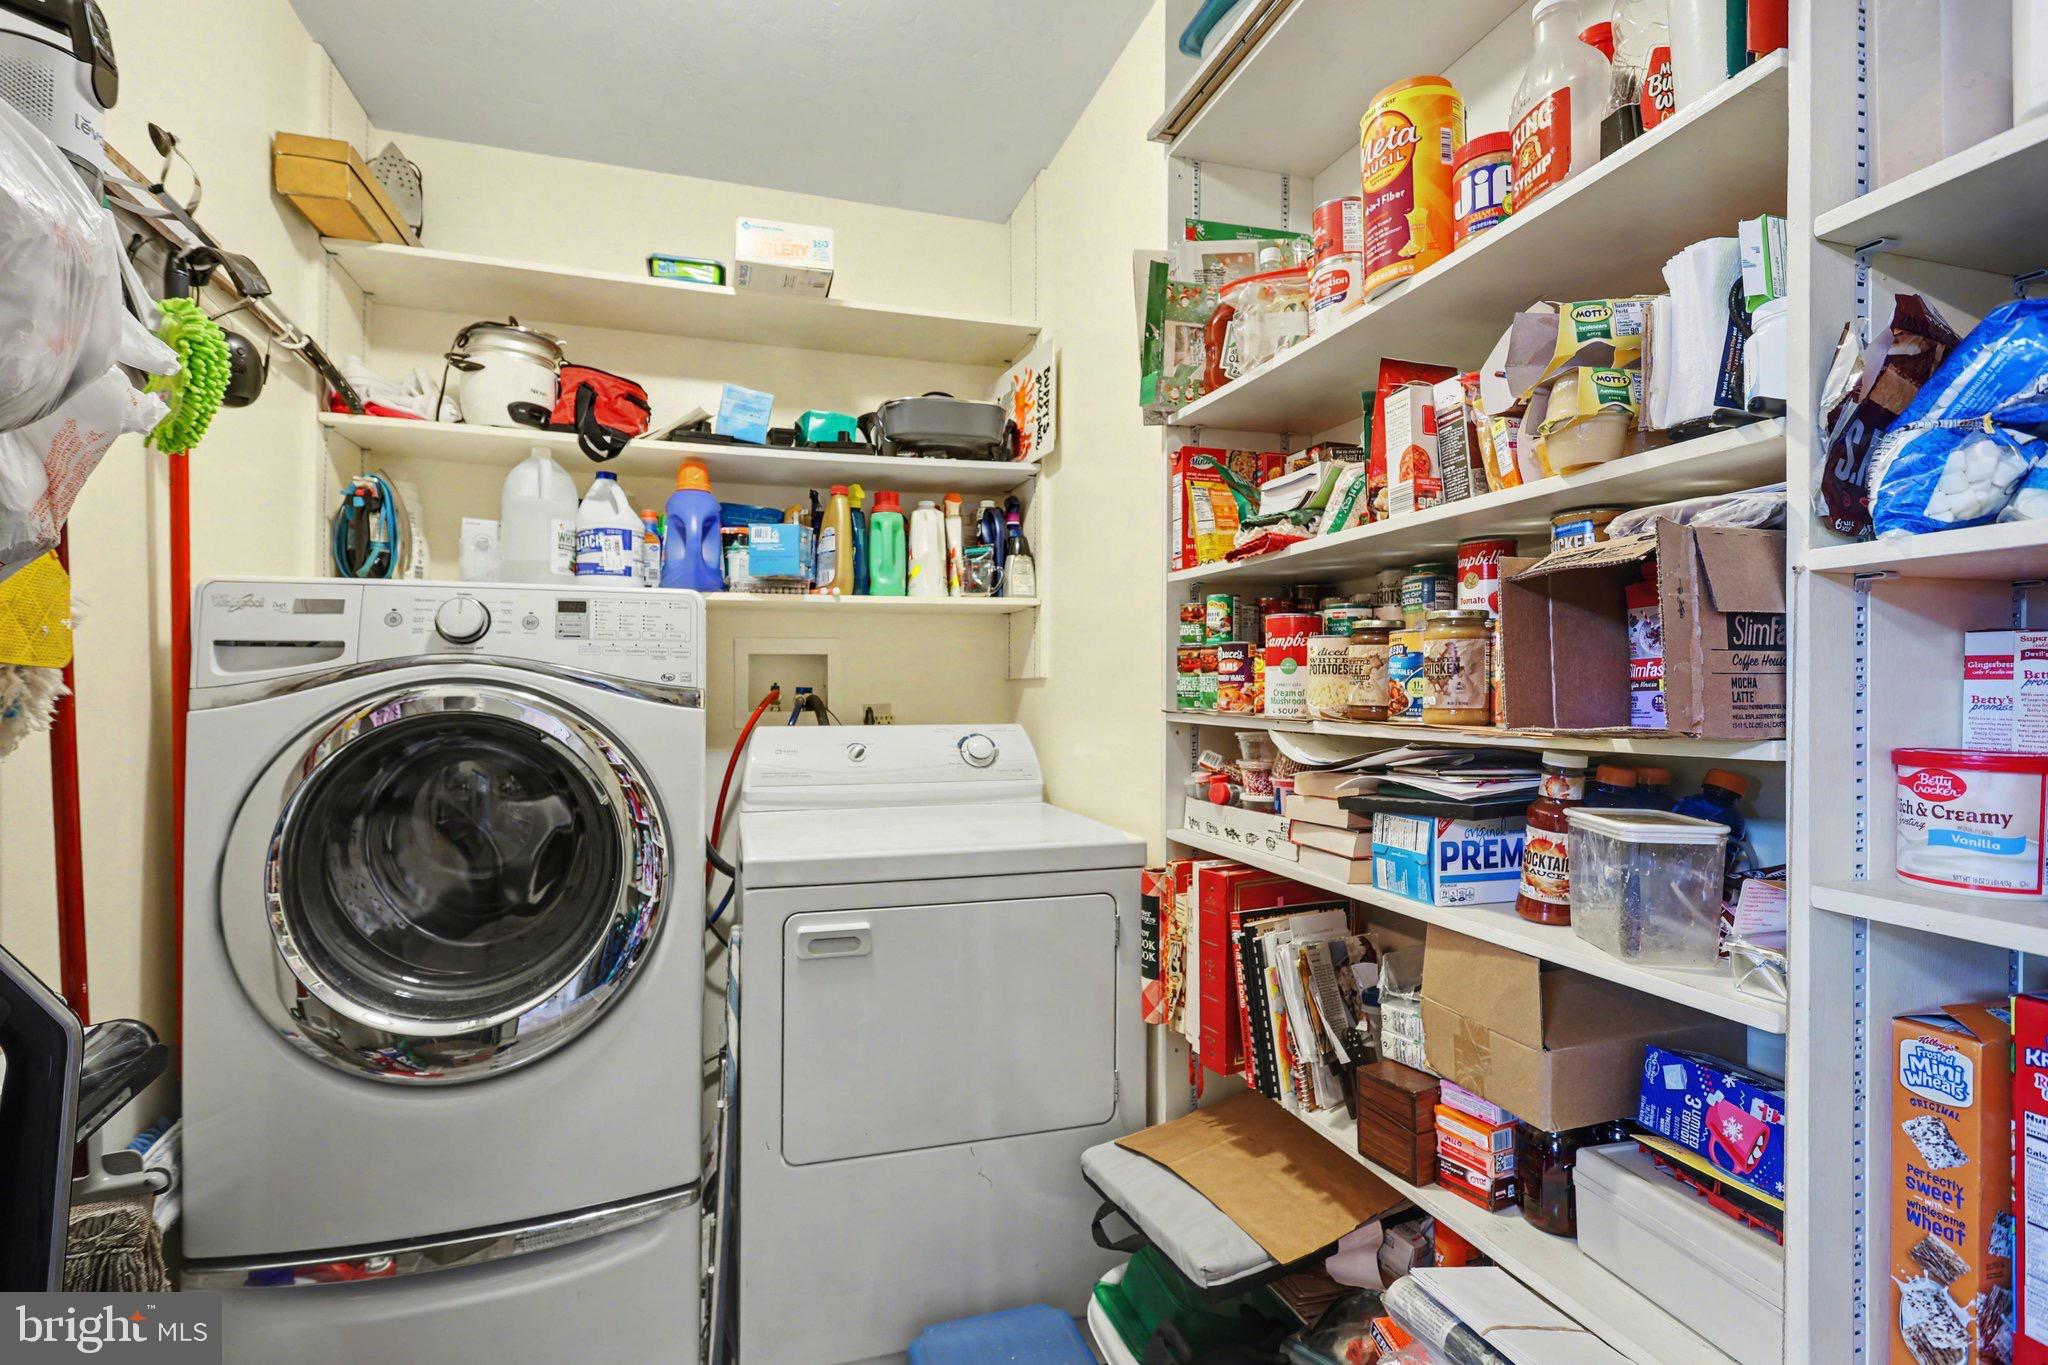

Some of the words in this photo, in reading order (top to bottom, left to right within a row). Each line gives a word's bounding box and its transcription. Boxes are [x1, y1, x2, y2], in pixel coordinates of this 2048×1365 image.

[1511, 99, 1554, 160] KING
[1513, 157, 1552, 199] SYRUP
[1454, 165, 1513, 221] Jif
[1575, 308, 1610, 319] MOTT'S
[1595, 376, 1628, 385] MOTT'S
[1460, 597, 1486, 605] Tomato
[1317, 648, 1349, 656] diced
[1309, 664, 1349, 675] POTATOES
[1732, 654, 1760, 671] Coffee
[1731, 678, 1758, 689] MOCHA
[1271, 697, 1307, 705] Mushroom
[1298, 689, 1305, 697] of
[1731, 691, 1755, 703] LATTE
[1971, 695, 2014, 705] Betty's
[1917, 772, 1953, 787] Betty
[1913, 782, 1960, 798] Crocker
[1898, 798, 1914, 815] ich
[1915, 801, 1928, 817] &
[1931, 804, 2014, 829] Creamy
[1464, 817, 1507, 848] original
[1951, 833, 2001, 850] Vanilla
[1440, 838, 1524, 871] PREM
[1918, 1036, 1955, 1052] Kellogg's
[1915, 1047, 1956, 1065] Frosted
[1908, 1055, 1964, 1084] Mini
[1904, 1069, 1967, 1102] Wheats
[1909, 1097, 1961, 1122] ORIGINAL
